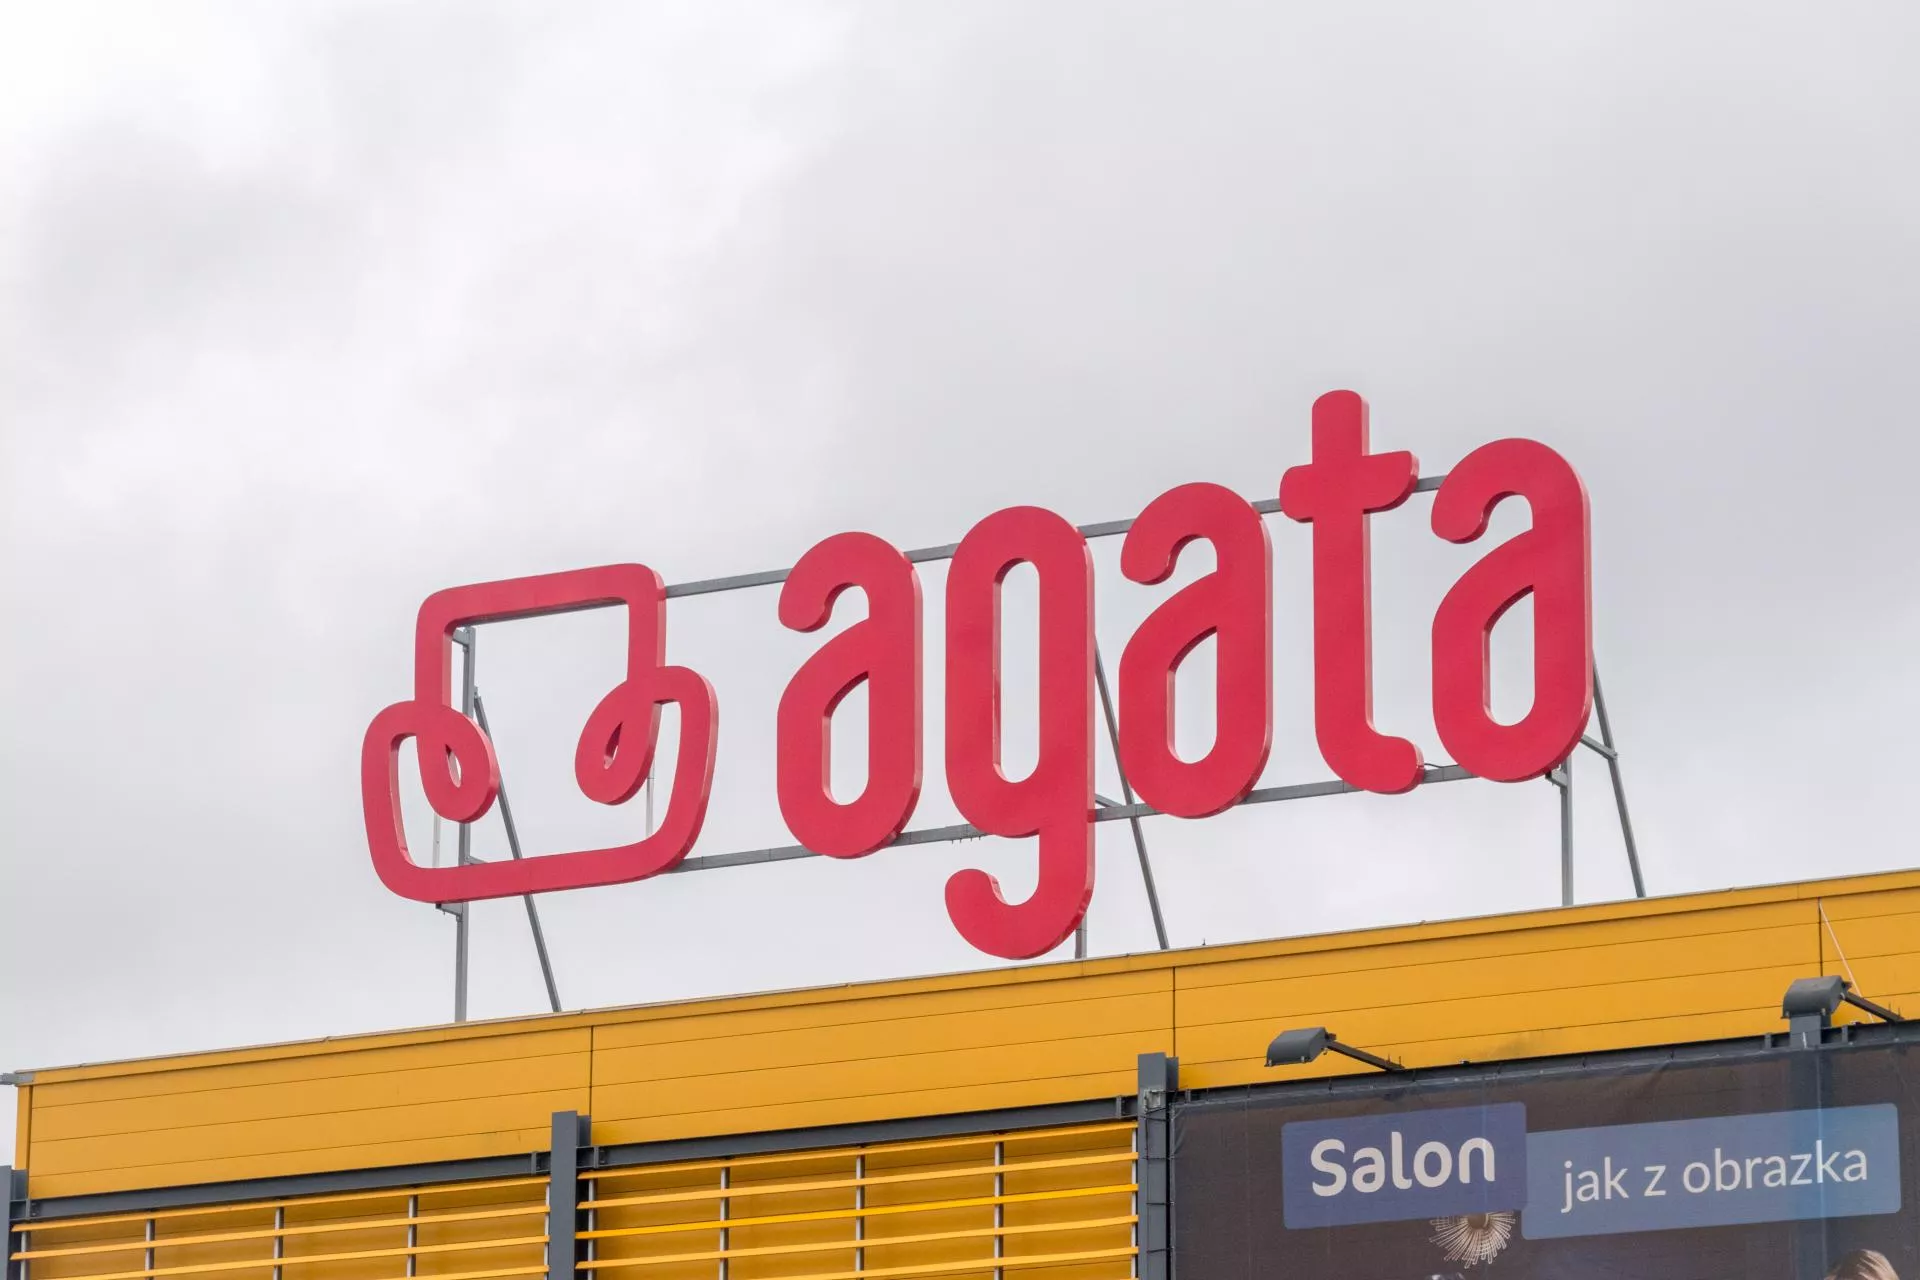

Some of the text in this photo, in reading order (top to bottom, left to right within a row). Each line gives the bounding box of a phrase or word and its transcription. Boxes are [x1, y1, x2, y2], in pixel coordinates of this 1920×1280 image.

[777, 389, 1593, 960] agata
[1310, 1131, 1496, 1197] Salon
[1560, 1140, 1869, 1214] jak z obrazka
